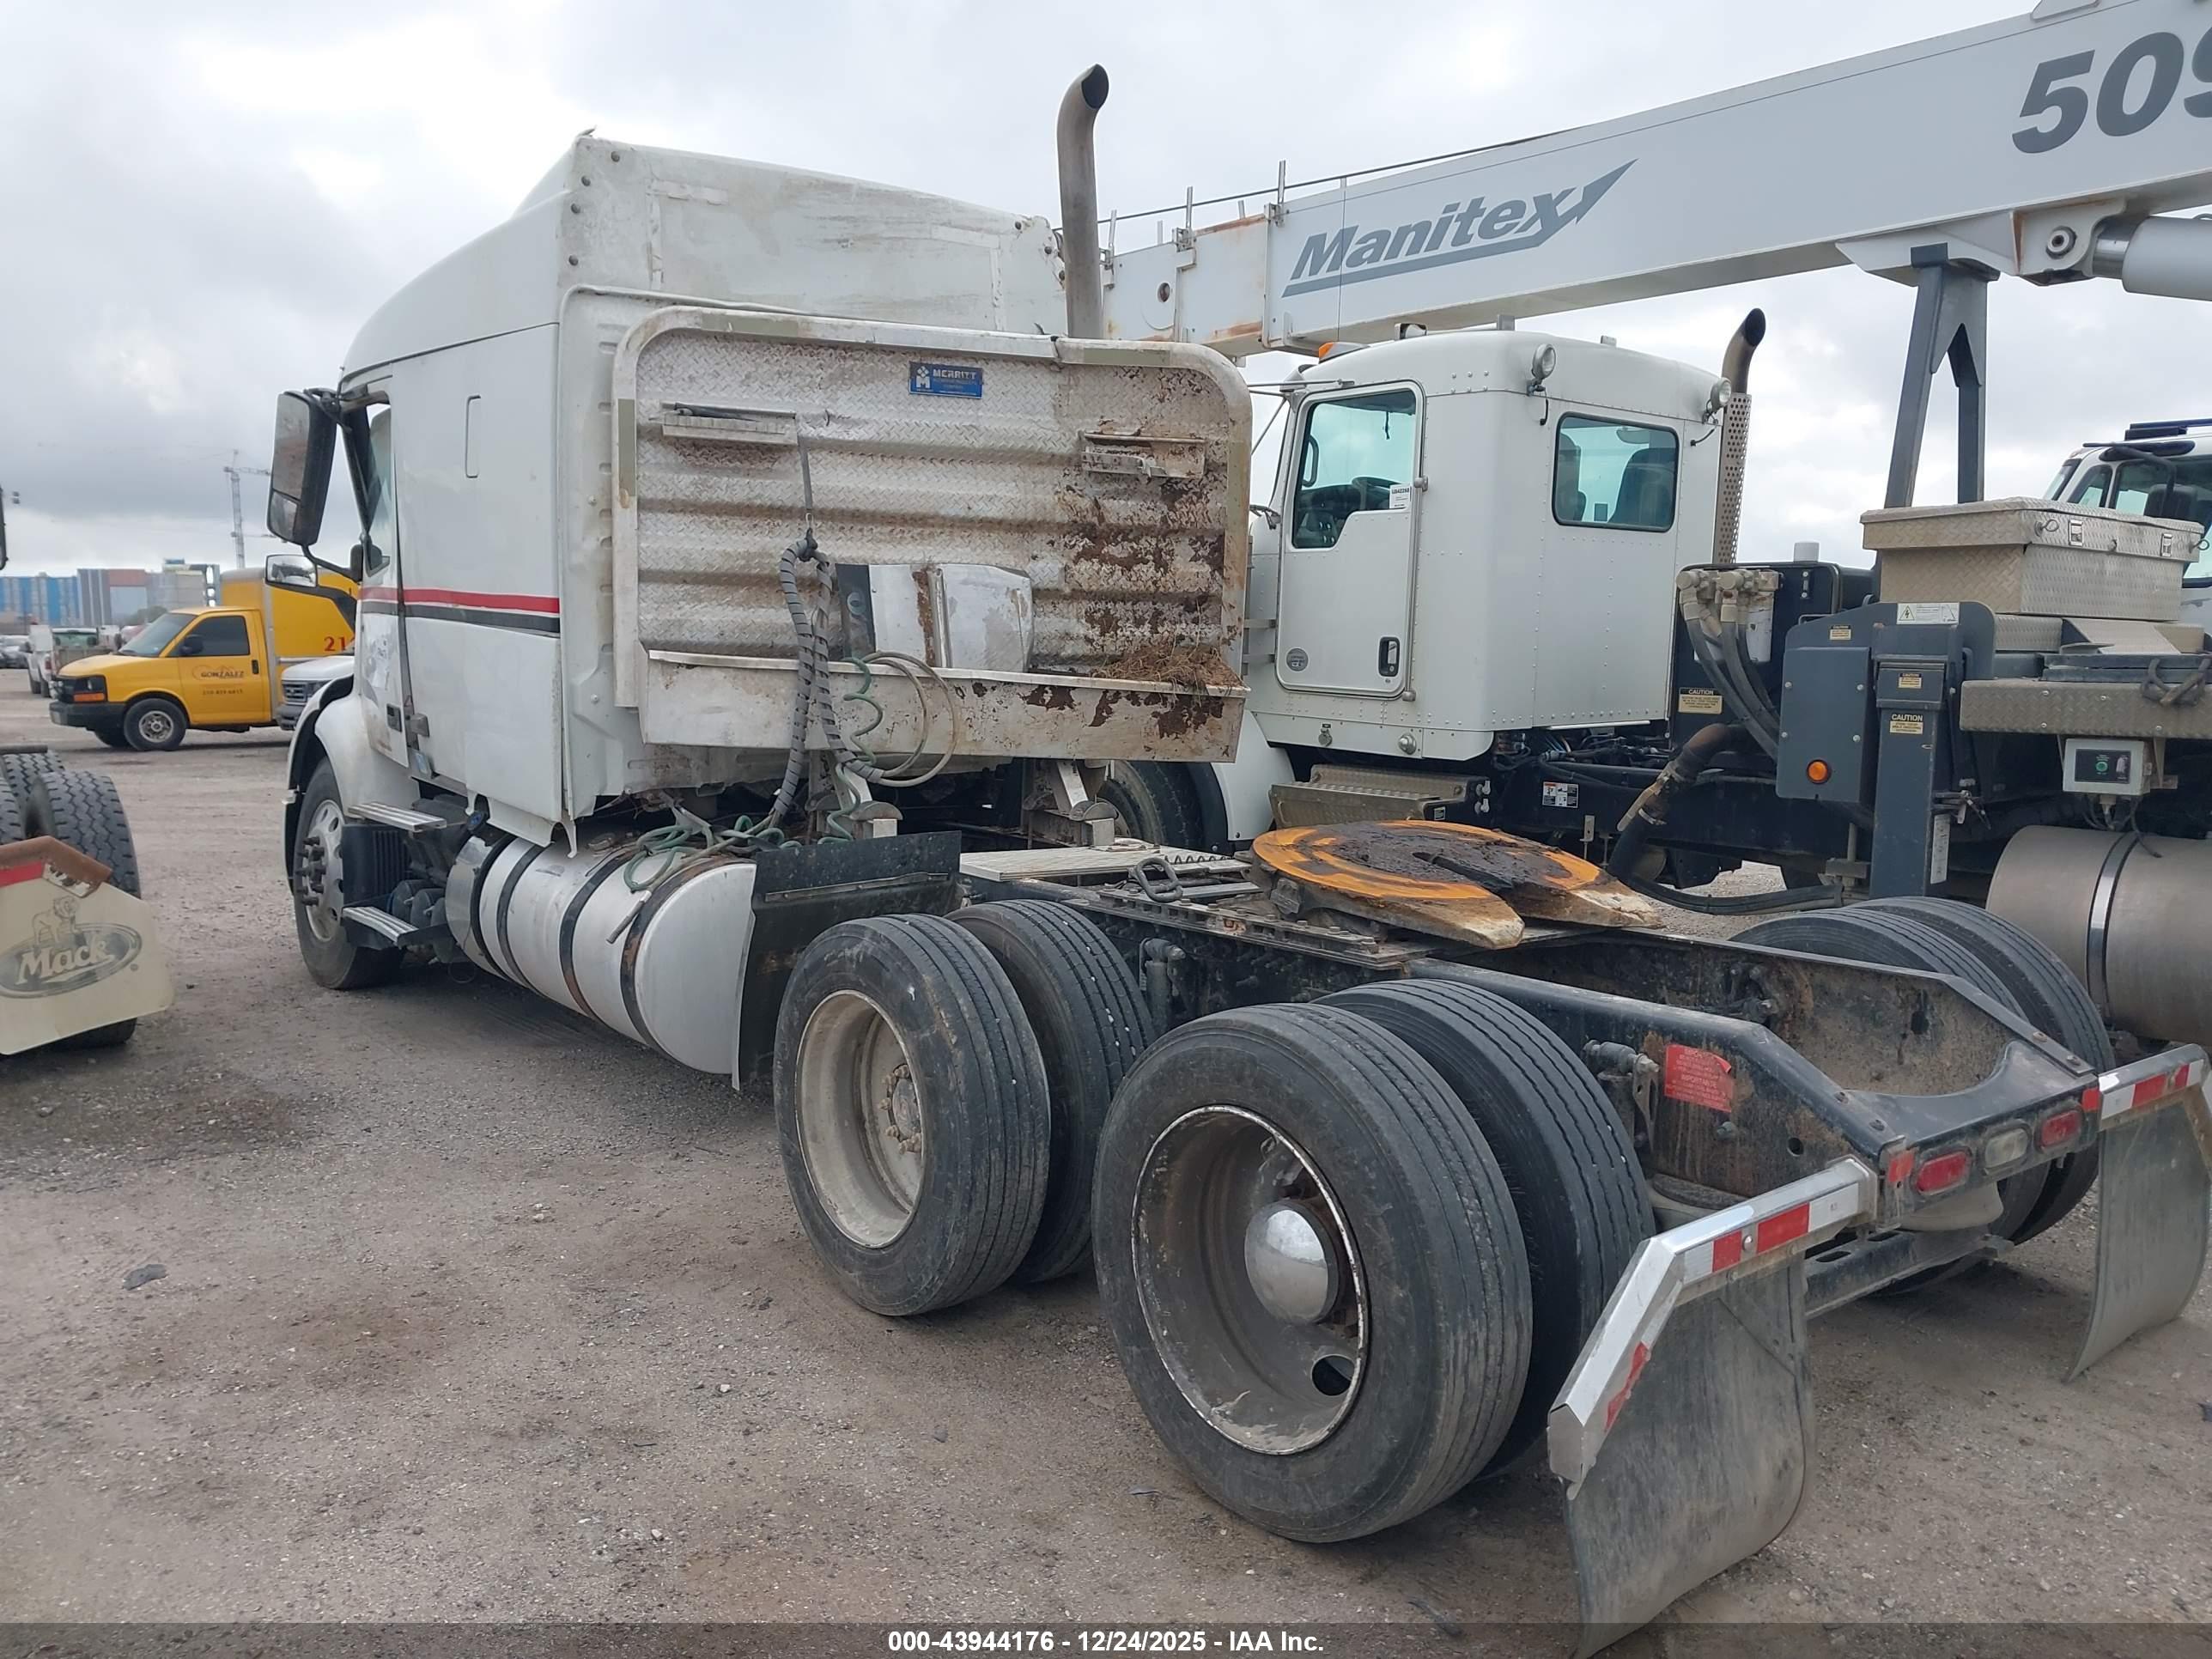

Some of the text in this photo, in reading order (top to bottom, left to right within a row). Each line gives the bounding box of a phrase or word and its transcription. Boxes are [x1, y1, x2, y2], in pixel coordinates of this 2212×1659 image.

[2012, 27, 2212, 154] 50
[1290, 186, 1577, 280] Manitex
[933, 368, 976, 380] MERRITT
[324, 635, 356, 652] 21
[1891, 714, 1923, 722] CAUTION
[15, 933, 108, 985] Mack
